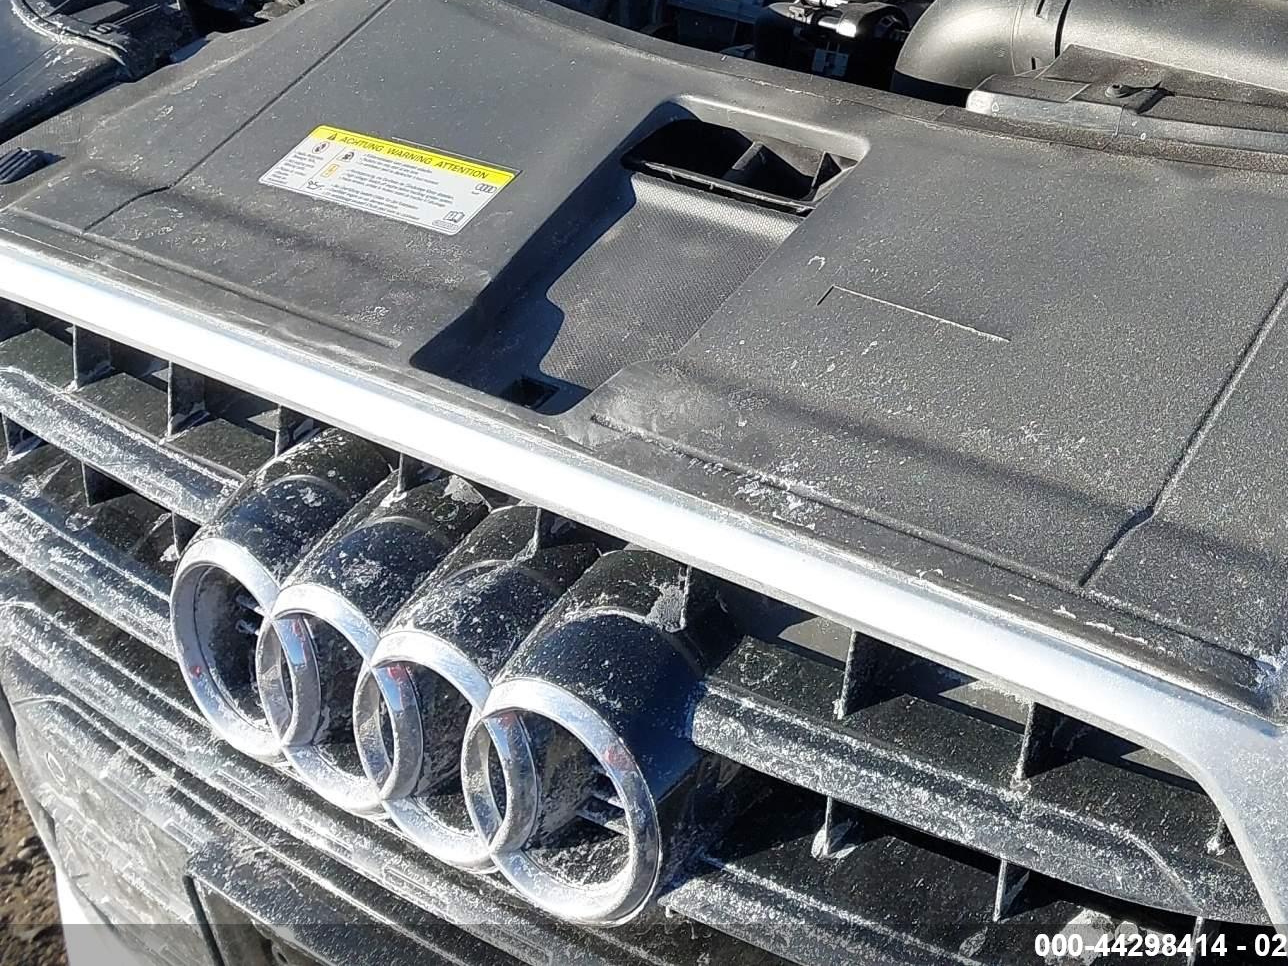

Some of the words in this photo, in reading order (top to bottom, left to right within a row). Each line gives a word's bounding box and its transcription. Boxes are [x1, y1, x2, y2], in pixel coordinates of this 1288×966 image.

[339, 136, 384, 152] ACHTUNG
[386, 147, 433, 165] WARNING
[434, 161, 490, 179] ATTENTION
